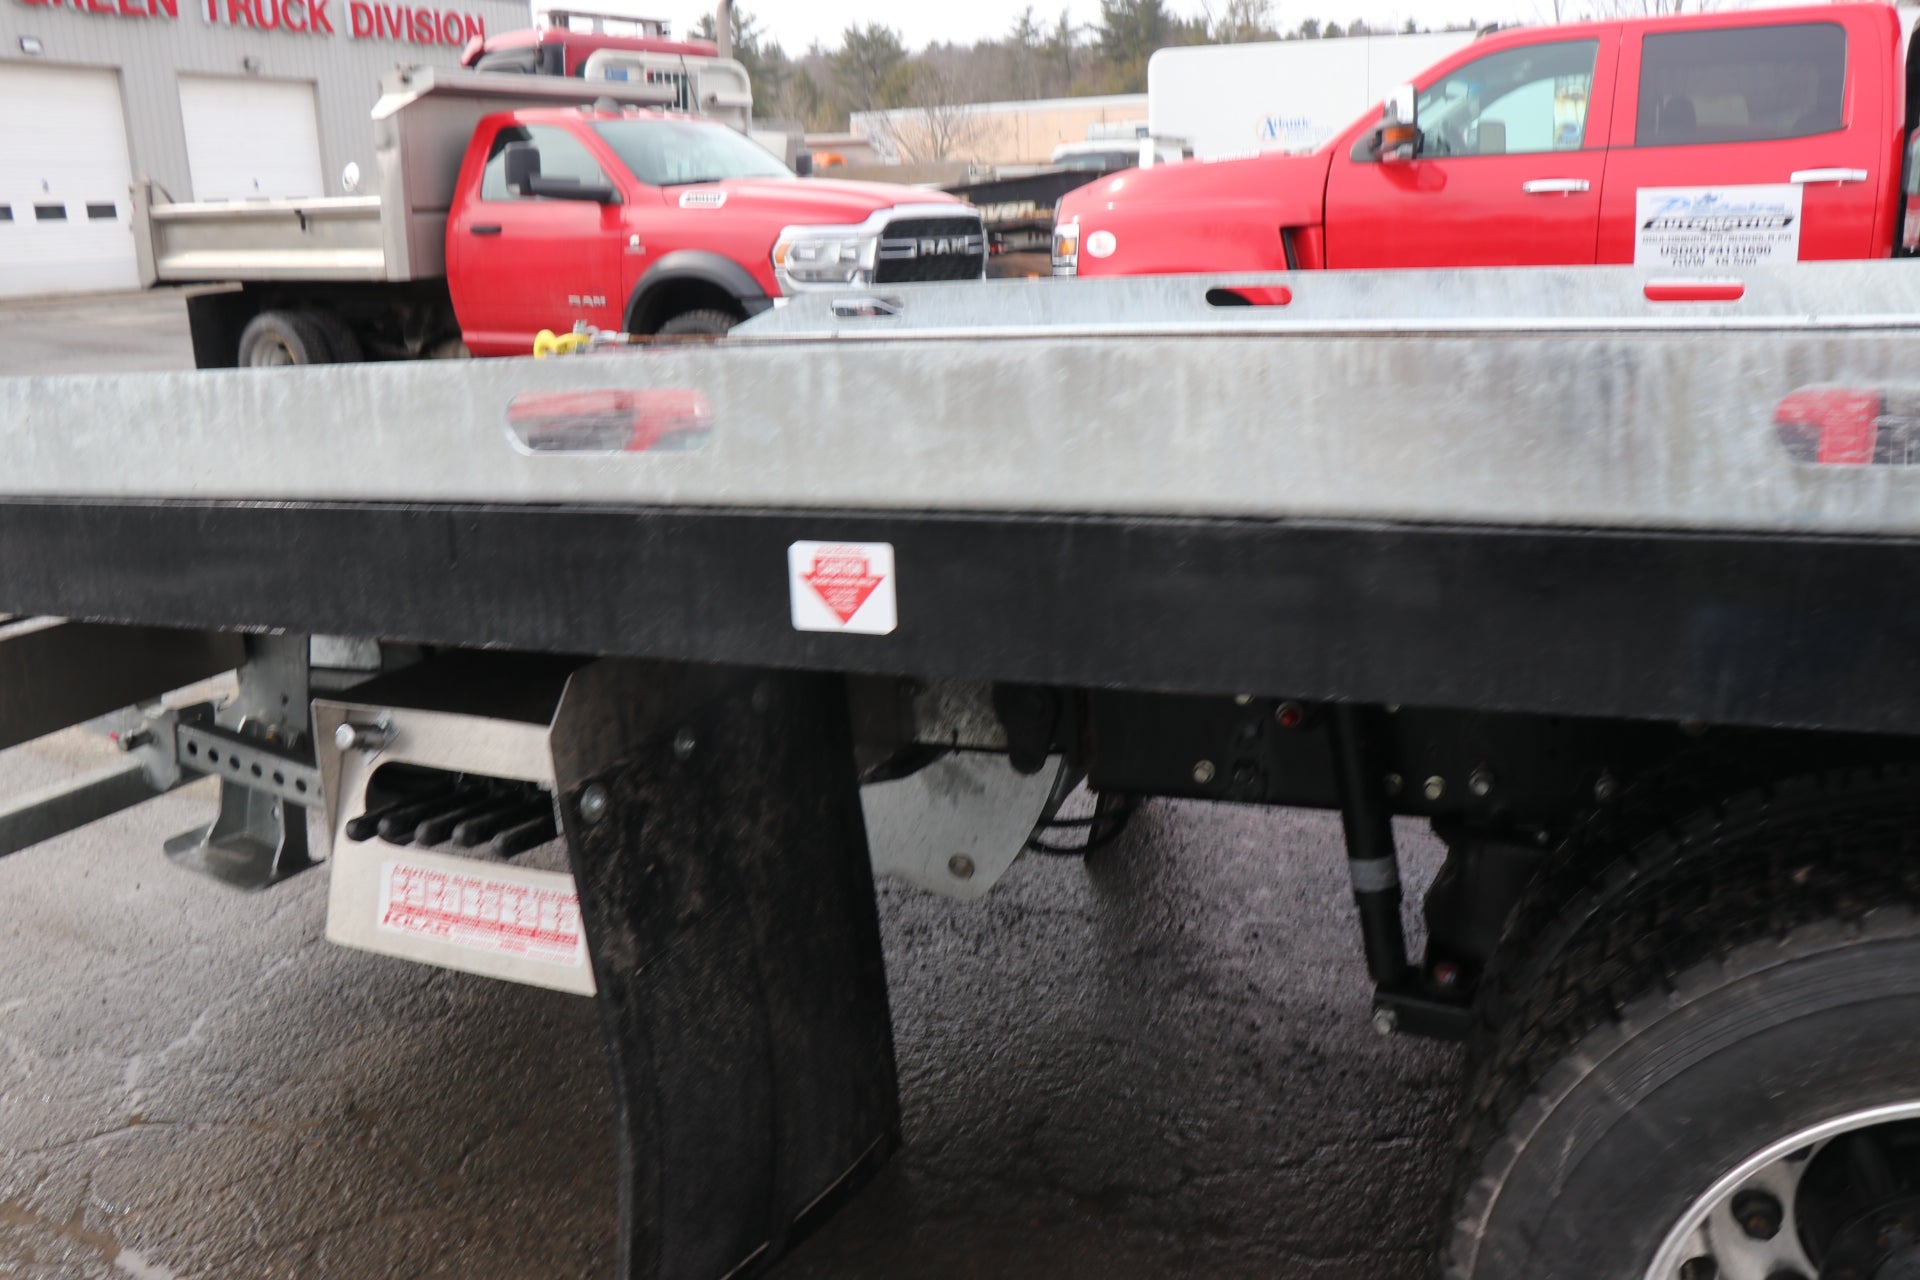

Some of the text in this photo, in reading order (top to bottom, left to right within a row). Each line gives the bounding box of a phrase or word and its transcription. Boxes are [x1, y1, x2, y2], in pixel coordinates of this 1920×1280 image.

[351, 1, 485, 46] DIVISION
[920, 237, 966, 256] RAM
[568, 294, 606, 308] RAM
